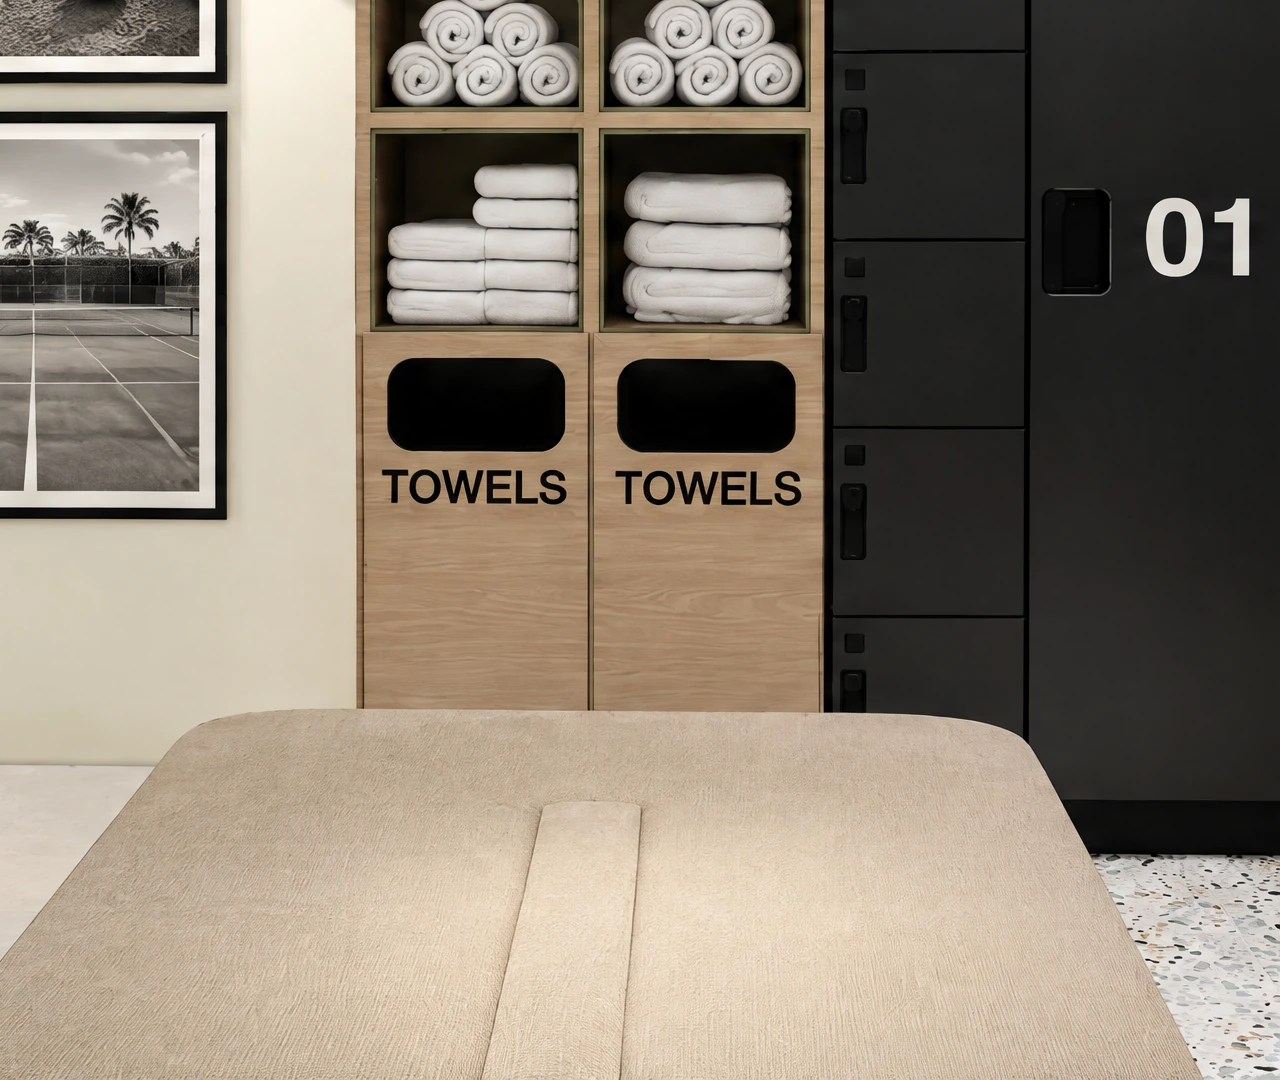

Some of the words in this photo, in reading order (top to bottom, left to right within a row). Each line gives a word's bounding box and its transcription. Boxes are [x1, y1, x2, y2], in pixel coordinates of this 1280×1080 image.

[1144, 197, 1252, 278] 01
[381, 469, 568, 505] TOWELS
[614, 470, 803, 507] TOWELS
